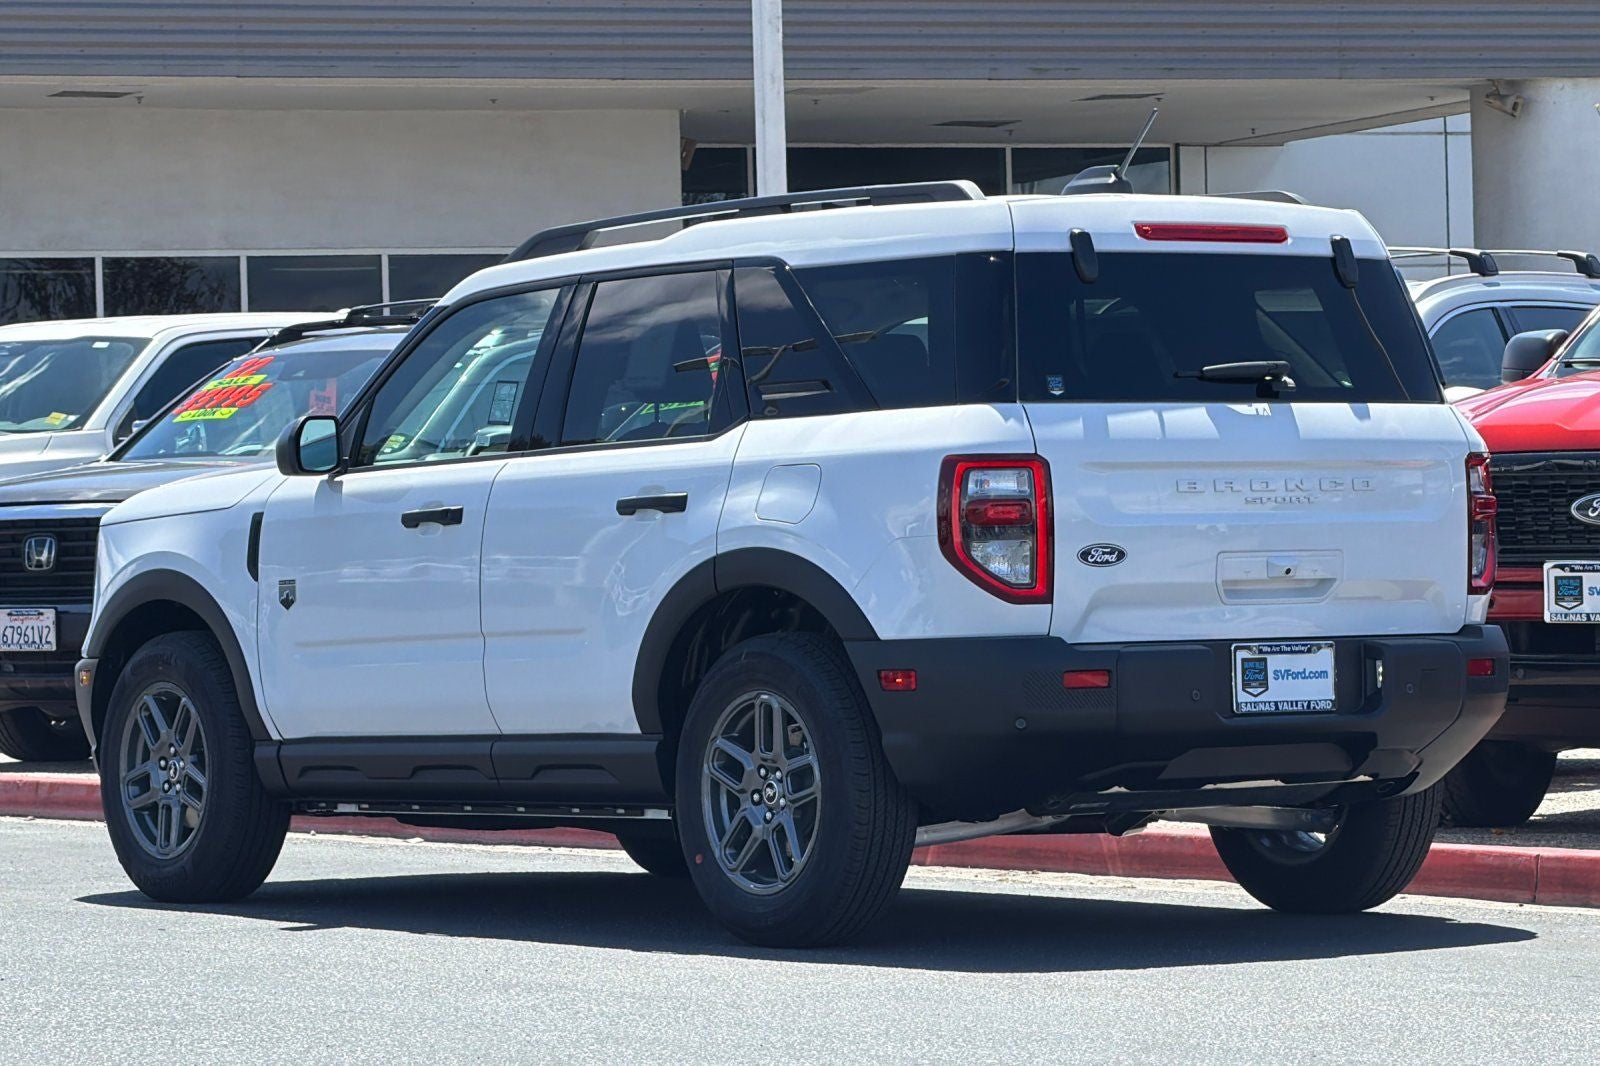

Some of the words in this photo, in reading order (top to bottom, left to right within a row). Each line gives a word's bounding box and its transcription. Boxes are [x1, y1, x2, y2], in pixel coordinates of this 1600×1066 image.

[1176, 478, 1377, 493] BRONCO
[1244, 495, 1317, 505] SPORT
[1087, 547, 1119, 563] Ford
[1550, 613, 1587, 622] SALINAS
[2, 625, 52, 645] 67961V2
[1272, 668, 1329, 681] SVFord.com
[1241, 701, 1276, 712] SALINAS
[1277, 700, 1309, 711] VALLEY
[1310, 699, 1333, 710] FORD
